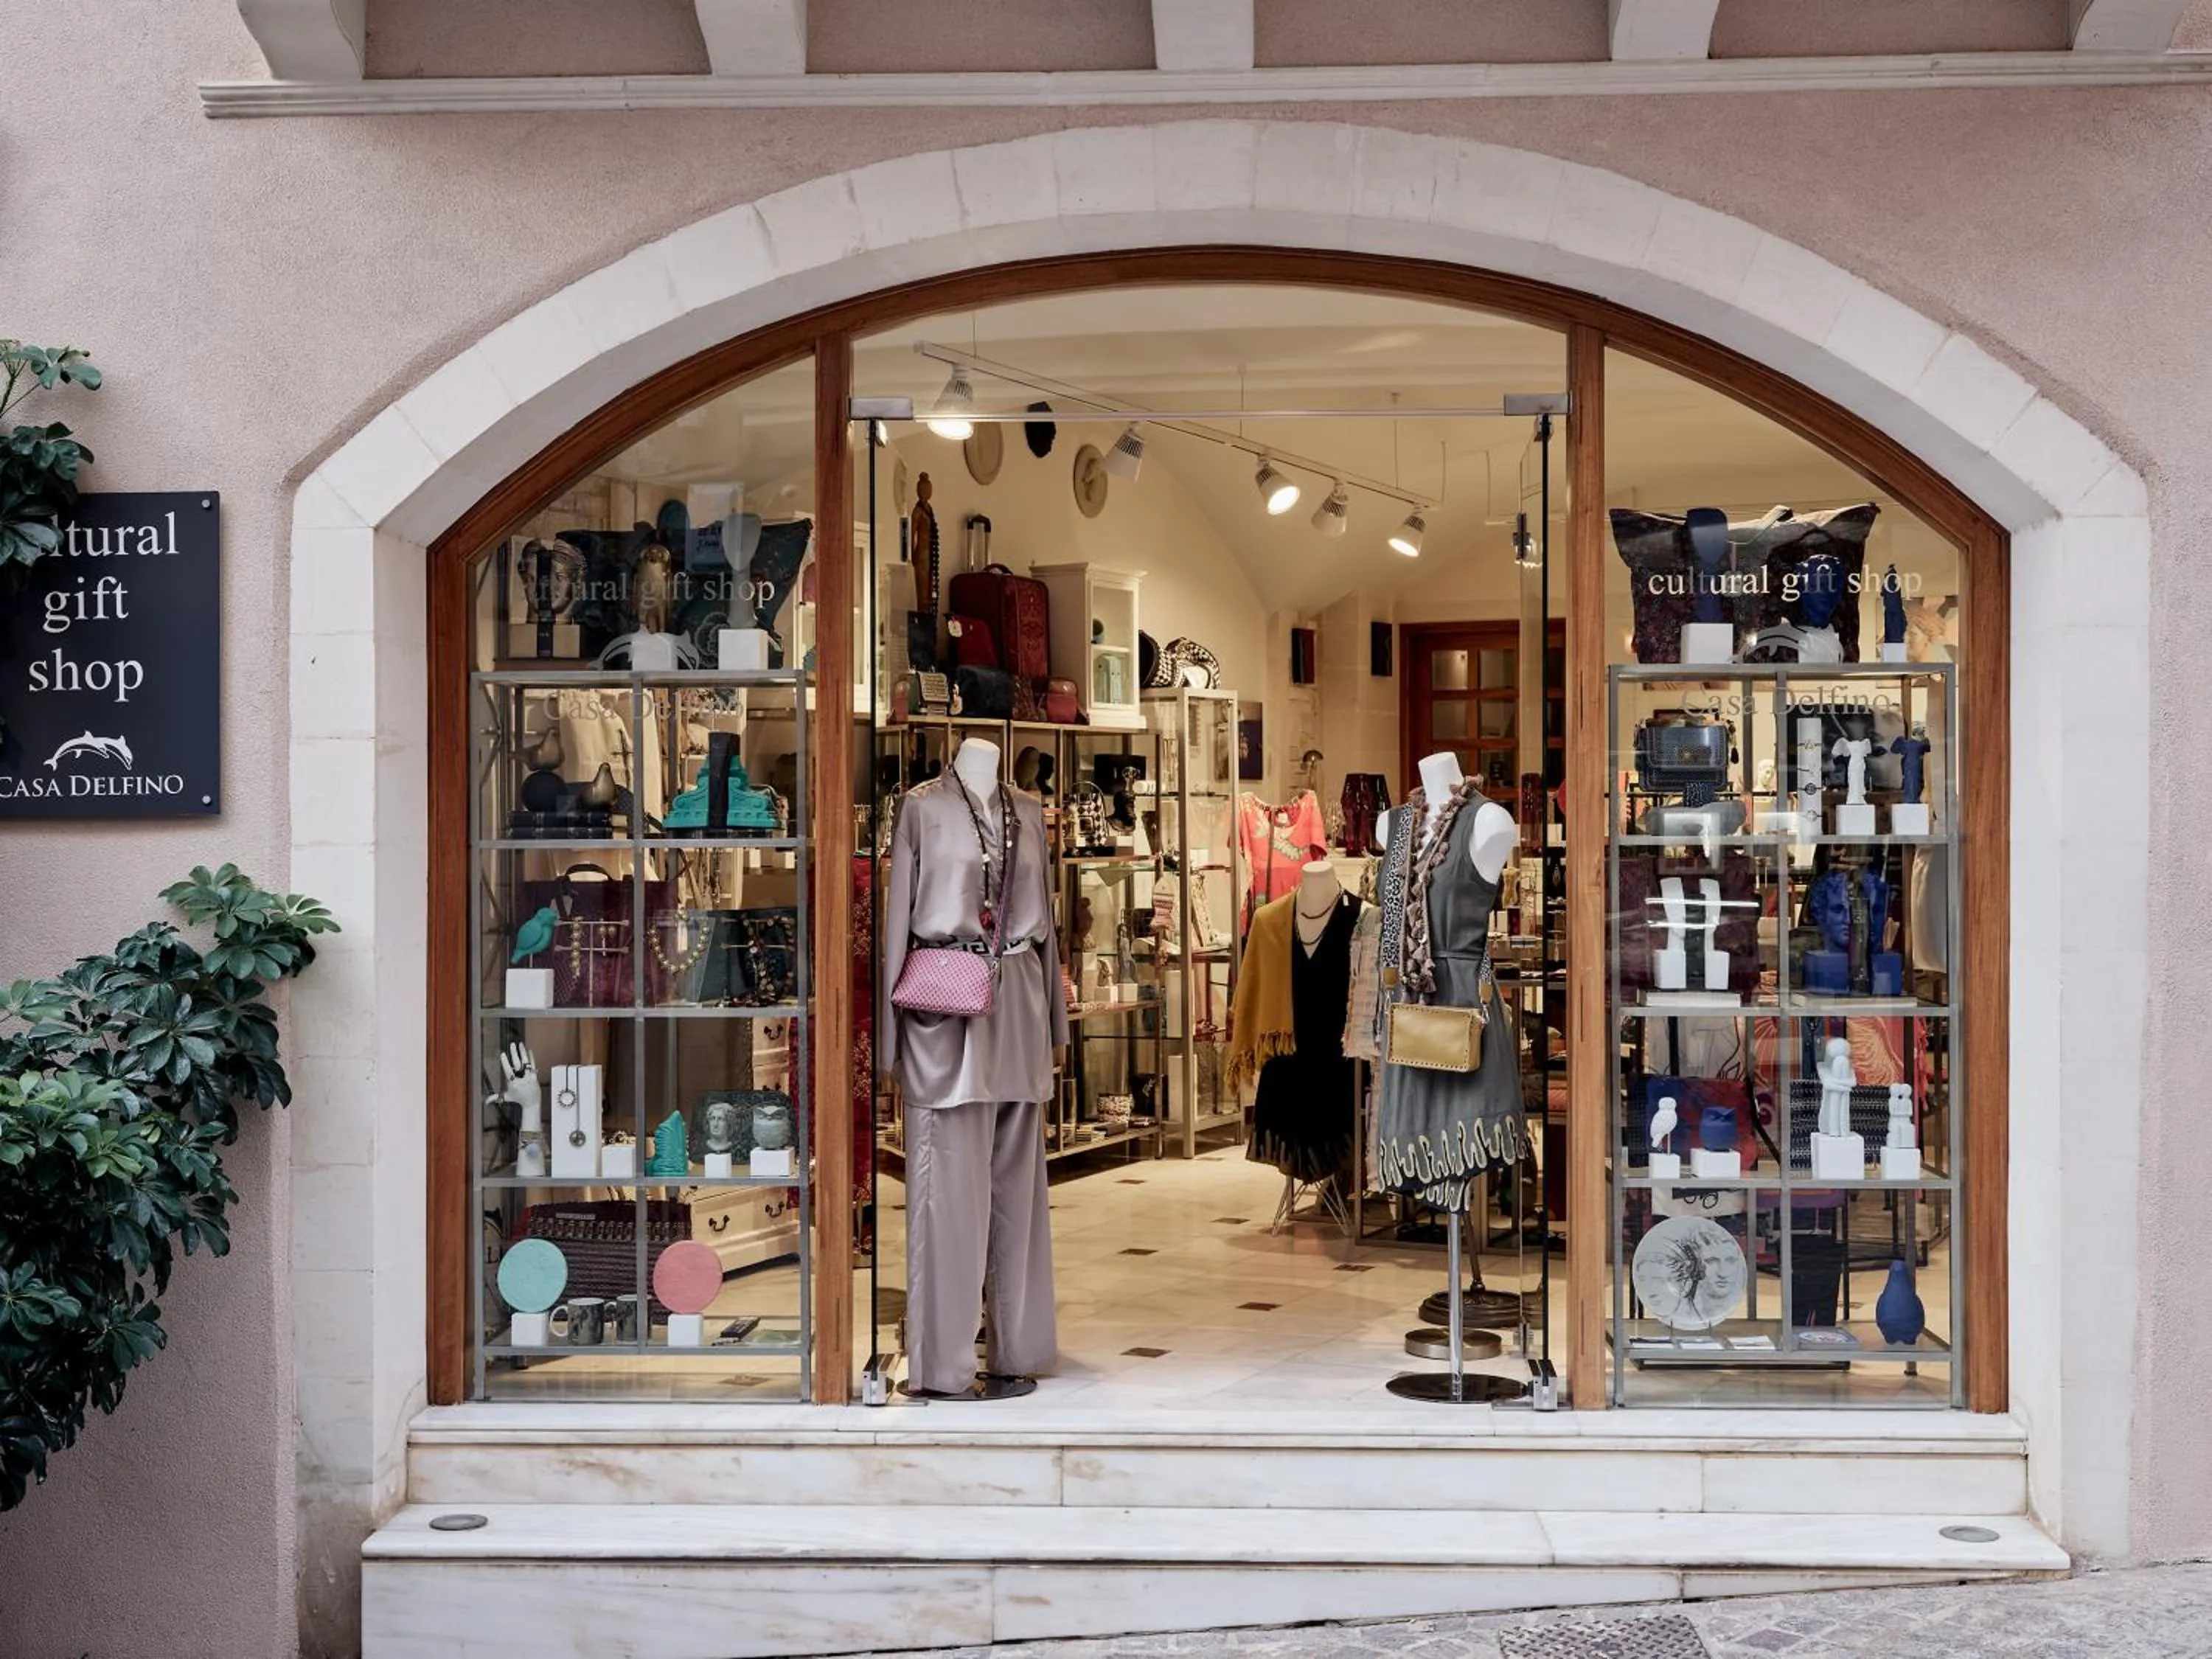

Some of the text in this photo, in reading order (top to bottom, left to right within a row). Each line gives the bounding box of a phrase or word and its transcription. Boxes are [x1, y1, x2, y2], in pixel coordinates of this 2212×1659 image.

[641, 571, 694, 609] gift
[703, 571, 776, 610] shop
[1647, 563, 1923, 602] cultural gift shop
[43, 576, 130, 633] gift
[28, 647, 145, 703] shop
[1680, 685, 1893, 717] Casa Delfino
[68, 773, 184, 797] DELFINO
